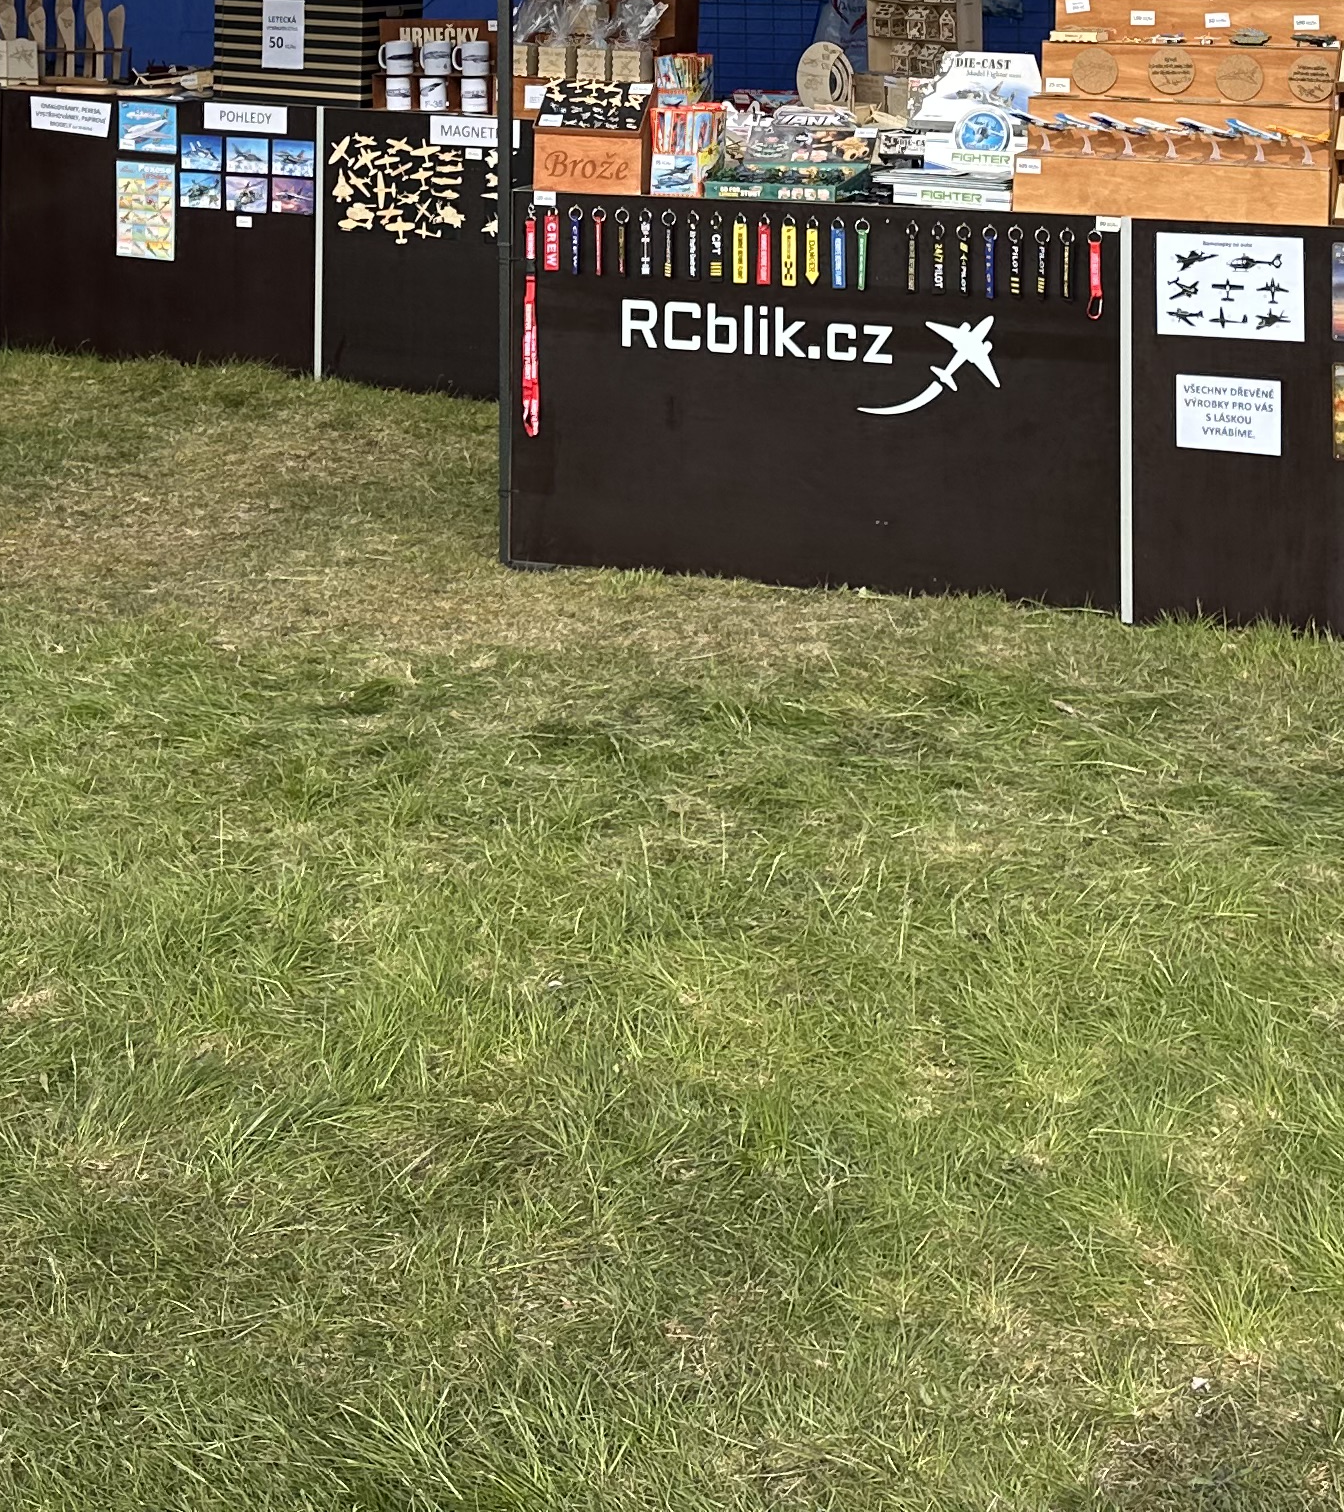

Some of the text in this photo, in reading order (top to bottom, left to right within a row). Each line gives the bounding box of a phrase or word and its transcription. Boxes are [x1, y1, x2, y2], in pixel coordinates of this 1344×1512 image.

[269, 36, 284, 49] 50
[399, 23, 479, 48] HRNEČKY
[956, 57, 1011, 70] DIE-CAST
[219, 110, 272, 125] POHLEDY
[778, 114, 844, 127] TANK
[440, 124, 498, 139] MAGNET
[544, 150, 629, 181] Brože
[951, 152, 1011, 165] FIGHTER
[920, 189, 983, 203] FIGHTER
[545, 222, 557, 267] CREW
[711, 233, 721, 255] CPT
[808, 239, 816, 273] DANGER
[1011, 245, 1019, 274] PILOT
[934, 263, 943, 289] PILOT
[620, 299, 893, 365] RCblik.cz
[1183, 384, 1274, 399] VŠECHNY DŘEVĚNÉ
[1184, 397, 1274, 413] VÝROBKY PRO VÁS
[1205, 412, 1252, 424] S LÁSKOU
[1201, 426, 1256, 440] VYRÁBÍME.
